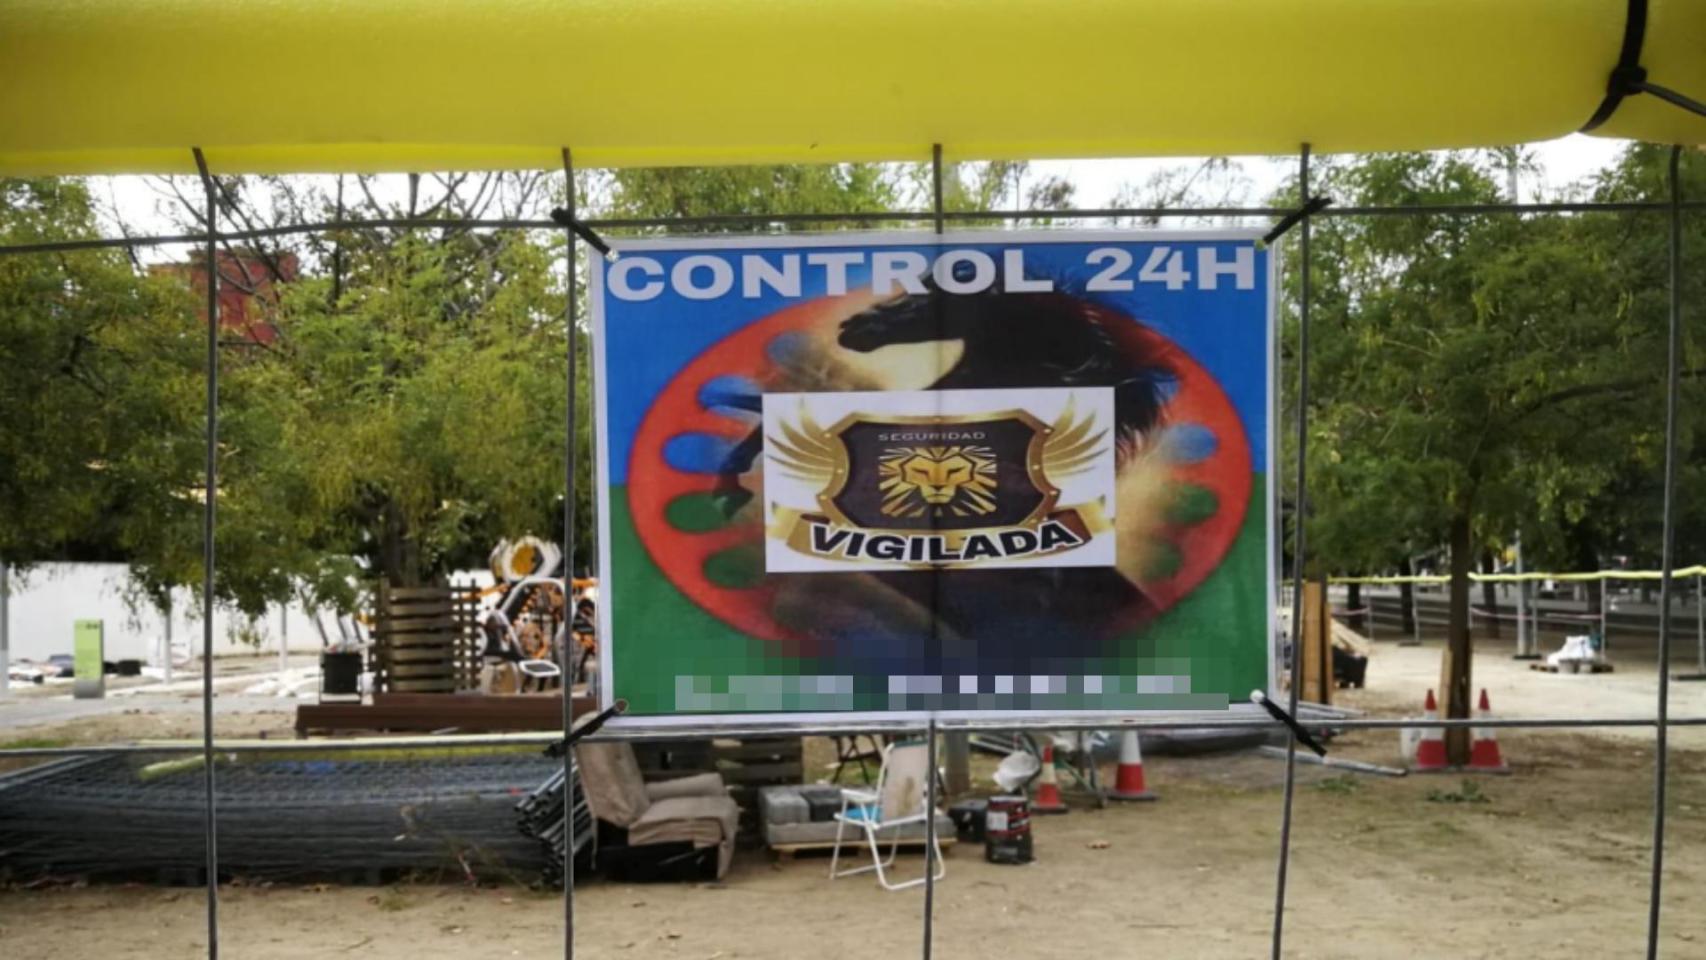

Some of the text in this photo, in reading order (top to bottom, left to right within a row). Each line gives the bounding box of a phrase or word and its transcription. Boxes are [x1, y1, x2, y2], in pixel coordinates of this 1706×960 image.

[607, 246, 1255, 300] CONTROL 24H
[878, 431, 986, 442] SEGURIDAD
[811, 520, 1082, 562] VIGILADA
